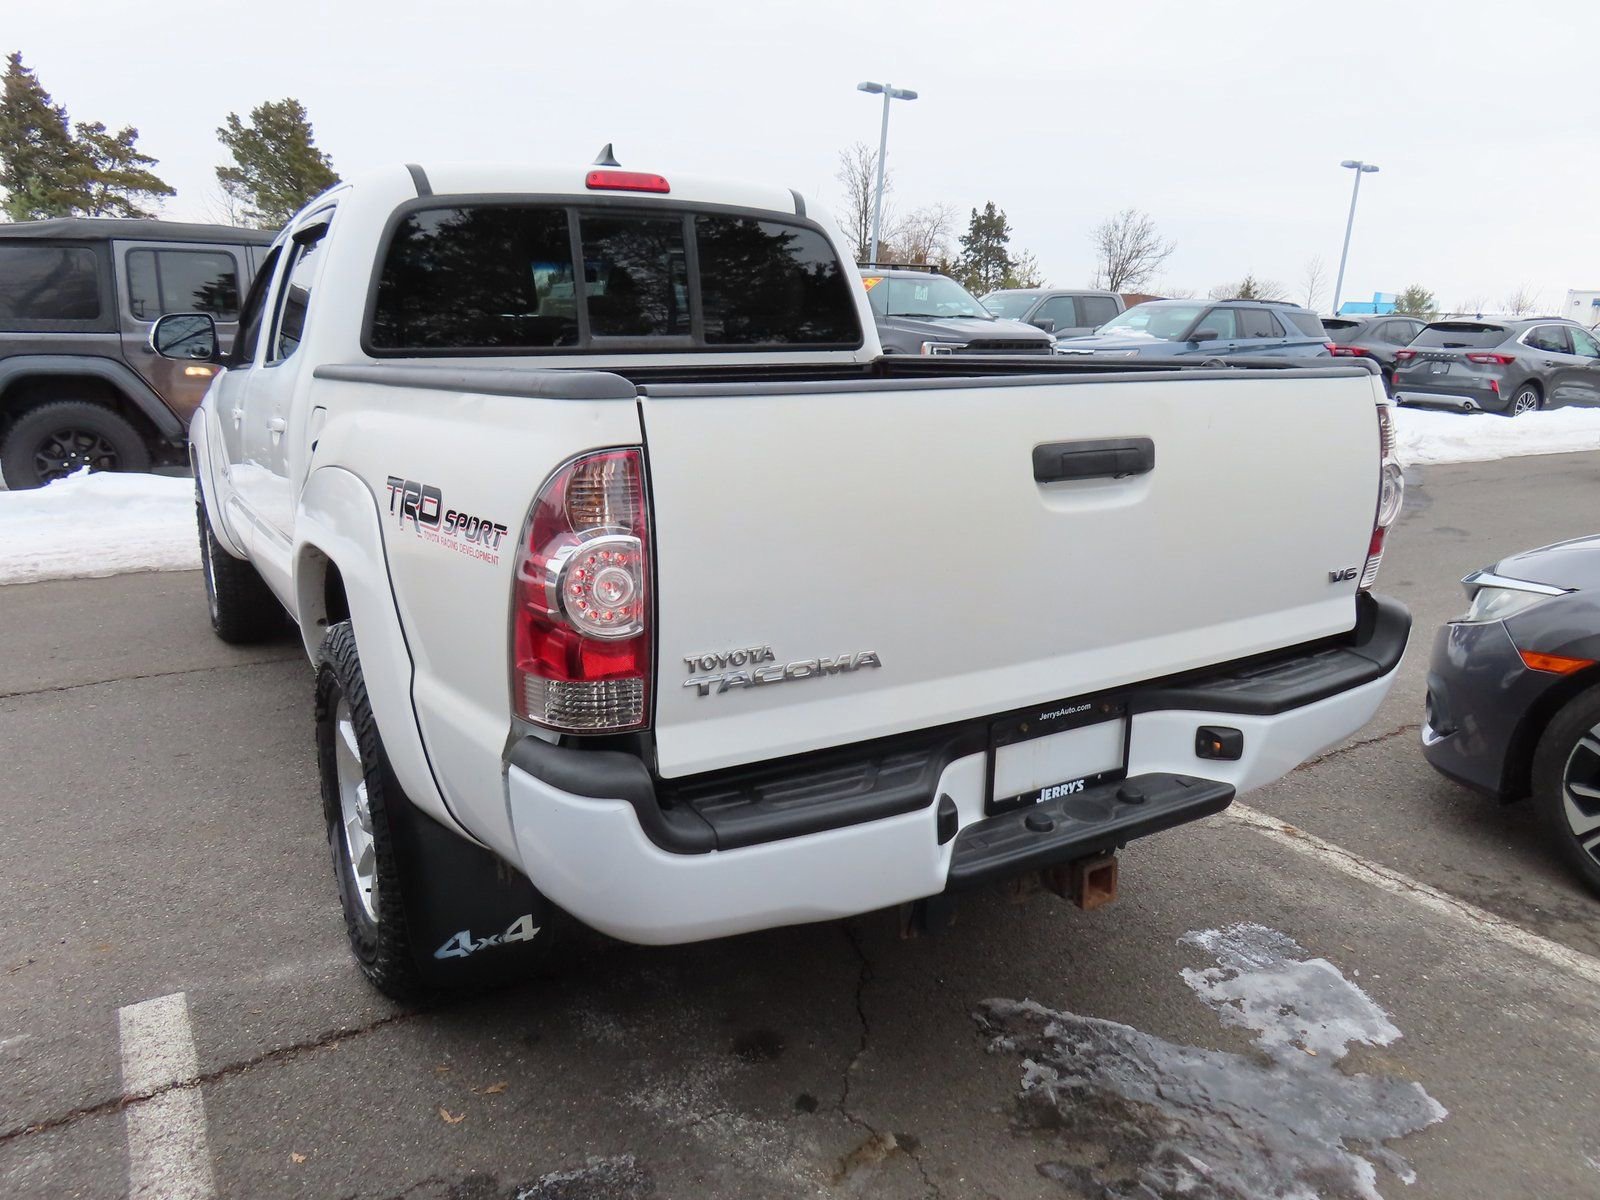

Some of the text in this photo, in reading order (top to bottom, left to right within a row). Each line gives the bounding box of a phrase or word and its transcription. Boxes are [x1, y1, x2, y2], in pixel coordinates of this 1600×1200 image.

[387, 476, 508, 551] TRD SPORT
[424, 530, 500, 566] TOYOTA RACING DEVELOPMENT
[1328, 567, 1358, 583] V6
[682, 650, 882, 697] TACOMA
[683, 645, 776, 673] TOYOTA
[1039, 703, 1092, 721] JerrysAuto.com
[1036, 779, 1085, 804] JERRY'S
[433, 913, 542, 960] 4x4
